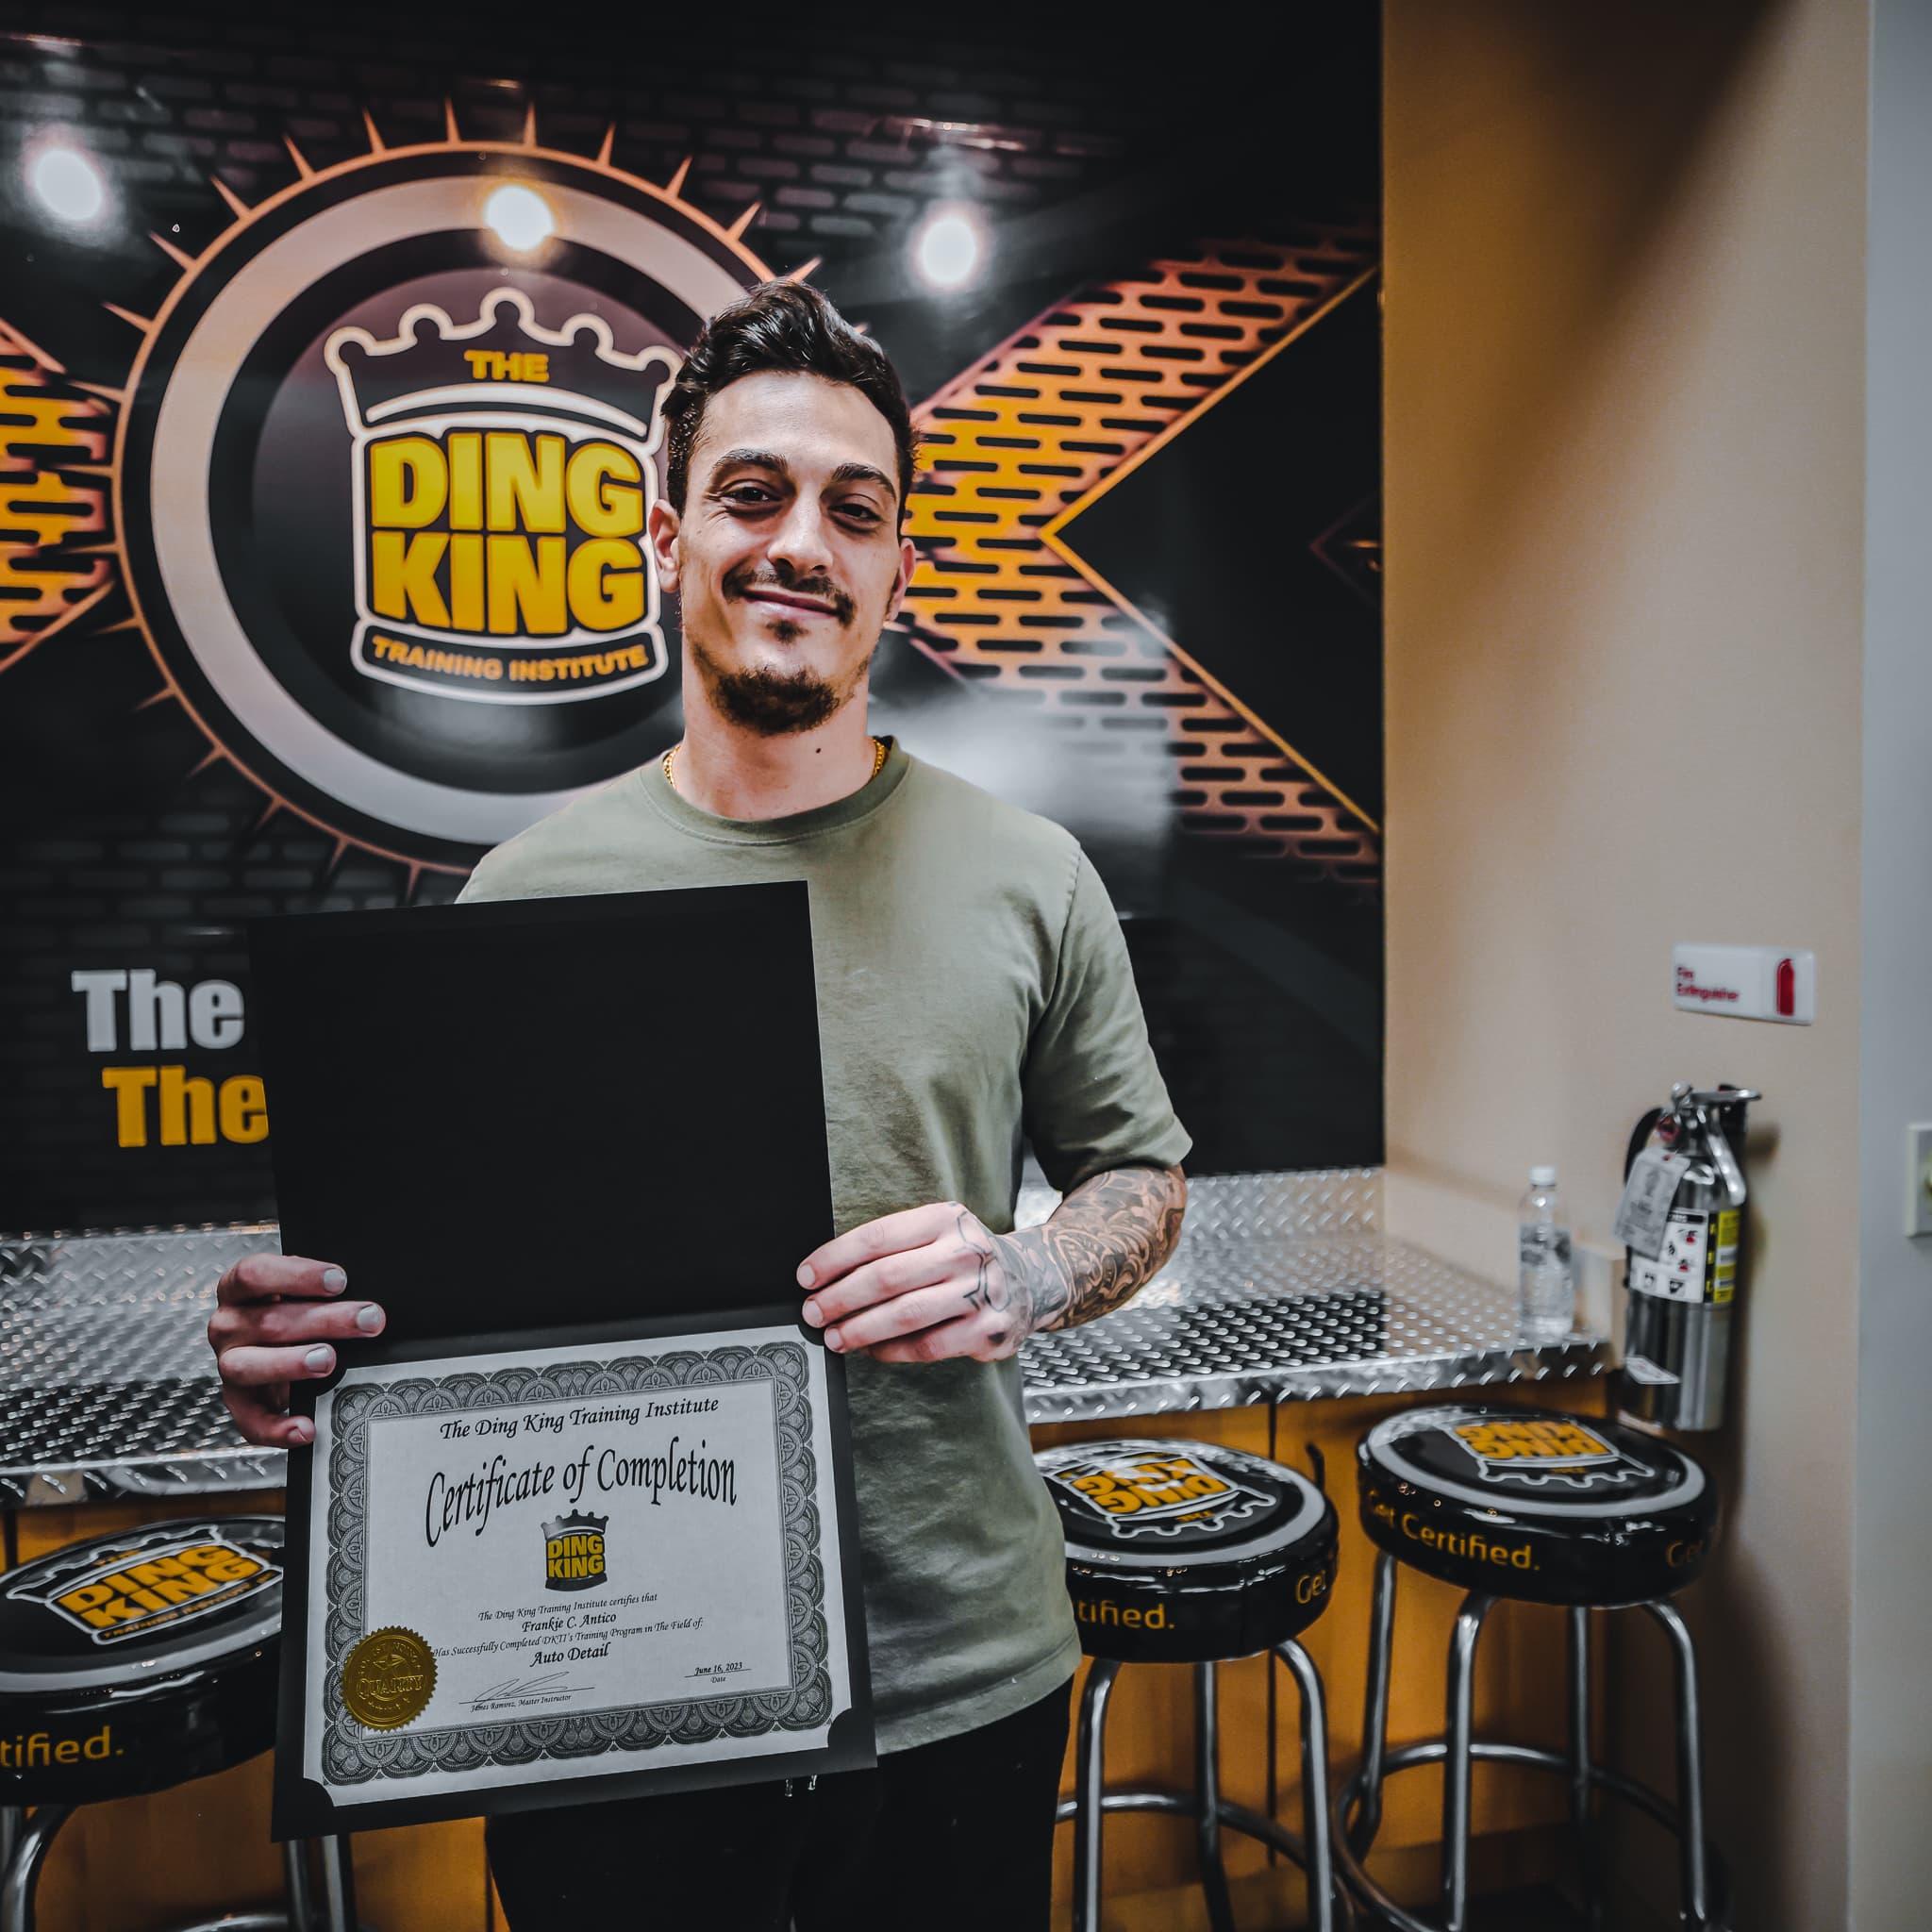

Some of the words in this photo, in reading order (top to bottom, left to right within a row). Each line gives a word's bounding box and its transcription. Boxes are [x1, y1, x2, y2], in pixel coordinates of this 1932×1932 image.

[464, 349, 550, 383] THE
[370, 431, 643, 539] DING
[372, 530, 644, 636] KING
[371, 635, 504, 681] TRAINING
[508, 644, 650, 682] INSTITUTE
[71, 968, 245, 1053] The
[102, 1064, 270, 1148] The
[440, 1420, 471, 1440] The
[475, 1417, 518, 1439] Ding
[523, 1413, 565, 1433] King
[569, 1406, 640, 1426] Training
[644, 1397, 719, 1419] Institute
[425, 1454, 555, 1548] Certificate
[562, 1444, 594, 1504] of
[597, 1436, 737, 1507] Completion
[1094, 1474, 1228, 1514] DING
[547, 1535, 603, 1558] DING
[1402, 1514, 1541, 1572] Certified.
[58, 1545, 236, 1614] DING
[548, 1555, 604, 1578] KING
[80, 1557, 264, 1629] KING
[478, 1611, 492, 1621] The
[495, 1609, 515, 1620] Ding
[517, 1607, 536, 1618] King
[538, 1604, 572, 1614] Training
[574, 1599, 608, 1610] Institute
[609, 1594, 640, 1607] certifies
[641, 1592, 658, 1602] that
[522, 1616, 563, 1633] Frankie
[567, 1616, 577, 1628] C.
[579, 1613, 617, 1628] Antico
[1074, 1599, 1175, 1629] tified.
[433, 1647, 450, 1657] Has
[451, 1641, 499, 1657] Successfully
[499, 1636, 541, 1651] Completed
[575, 1630, 608, 1641] Training
[609, 1626, 642, 1639] Program
[644, 1624, 653, 1633] in
[655, 1621, 669, 1632] The
[670, 1618, 691, 1630] Field
[692, 1617, 704, 1630] of:
[529, 1651, 564, 1668] Auto
[567, 1642, 611, 1661] Detail
[694, 1667, 711, 1676] June
[725, 1661, 742, 1672] 2023
[518, 1698, 540, 1707] Master
[541, 1694, 572, 1704] Instructor
[0, 1725, 124, 1767] tified.
